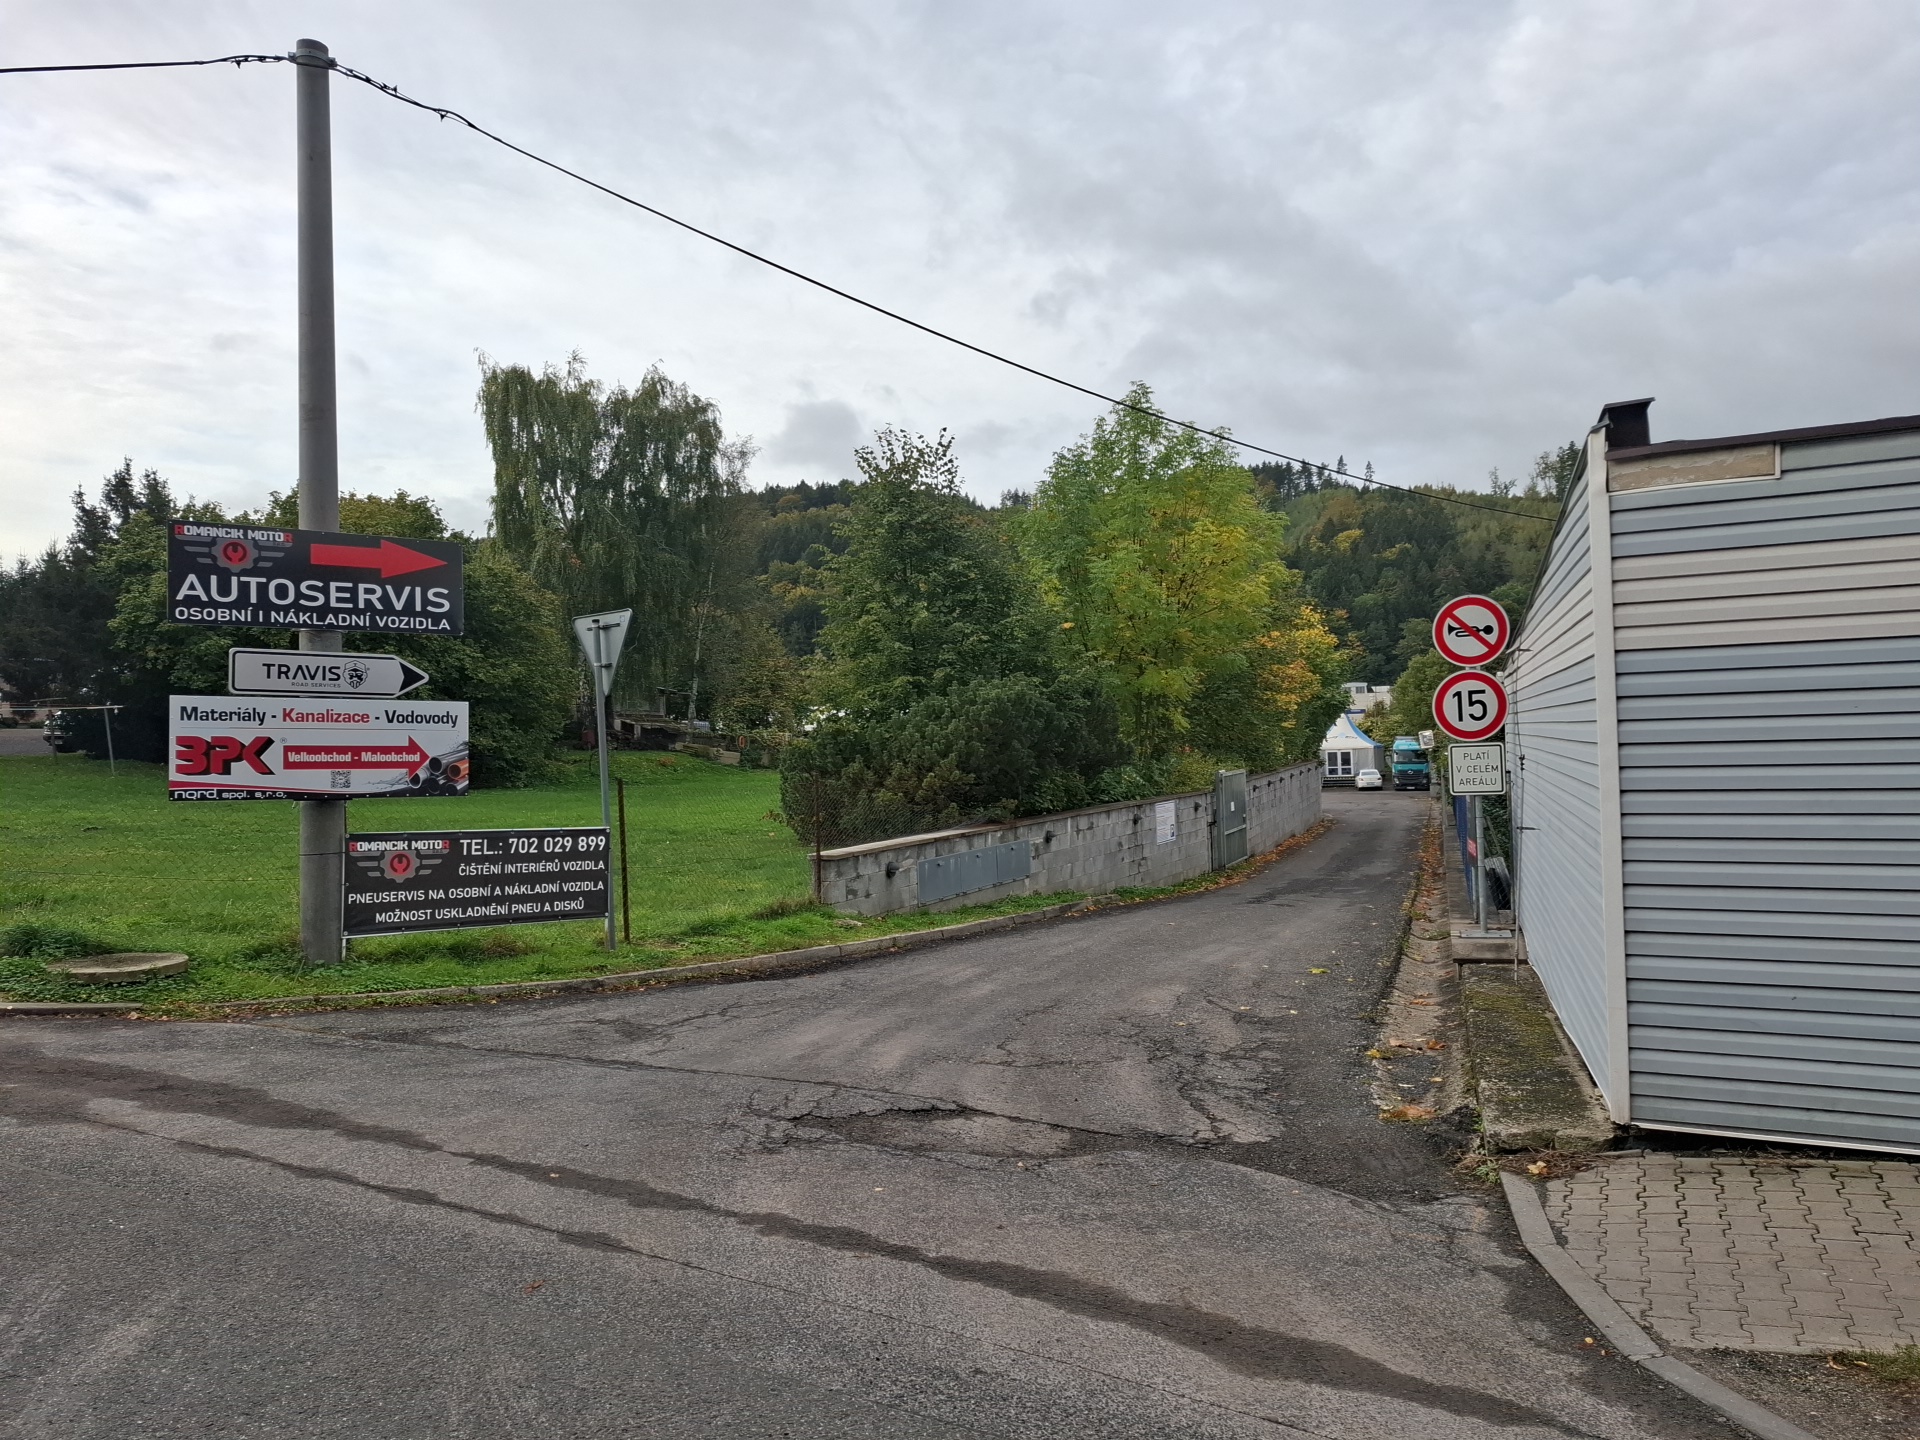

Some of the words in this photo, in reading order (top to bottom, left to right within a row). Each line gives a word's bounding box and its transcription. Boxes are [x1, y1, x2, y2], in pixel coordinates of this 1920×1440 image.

[174, 524, 244, 539] ROMANCIK
[247, 530, 293, 543] MOTOR
[175, 573, 451, 613] AUTOSERVIS
[175, 607, 253, 622] OSOBNÍ
[259, 610, 263, 622] I
[270, 609, 370, 627] NÁKLADNÍ
[375, 616, 450, 630] VOZIDLA
[262, 663, 341, 681] TRAVIS
[1452, 689, 1488, 722] 15
[180, 706, 266, 726] Materiály
[282, 708, 370, 724] Kanalizace
[384, 709, 458, 728] Vodovody
[288, 751, 352, 763] Velkoobchod
[361, 752, 420, 762] Maloobchod
[1463, 750, 1490, 760] PLATÍ
[1466, 763, 1499, 773] CELÉM
[1459, 775, 1497, 786] AREÁLU
[174, 789, 216, 799] nord
[222, 791, 250, 799] spol.
[349, 841, 408, 852] ROMANCIK
[412, 840, 450, 850] MOTOR
[460, 839, 502, 856] TEL.:
[509, 838, 538, 854] 702
[543, 837, 572, 853] 029
[578, 836, 606, 852] 899
[458, 862, 502, 876] ČIŠTĚNÍ
[504, 859, 560, 874] INTERIÉRŮ
[563, 860, 605, 871] VOZIDLA
[348, 890, 425, 905] PNEUSERVIS
[428, 889, 445, 900] NA
[448, 884, 491, 899] OSOBNÍ
[494, 886, 502, 896] A
[505, 880, 560, 895] NÁKLADNÍ
[562, 881, 604, 892] VOZIDLA
[375, 906, 431, 924] MOŽNOST
[435, 901, 509, 919] USKLADNĚNÍ
[512, 902, 541, 914] PNEU
[543, 902, 552, 912] A
[554, 897, 584, 911] DISKŮ
